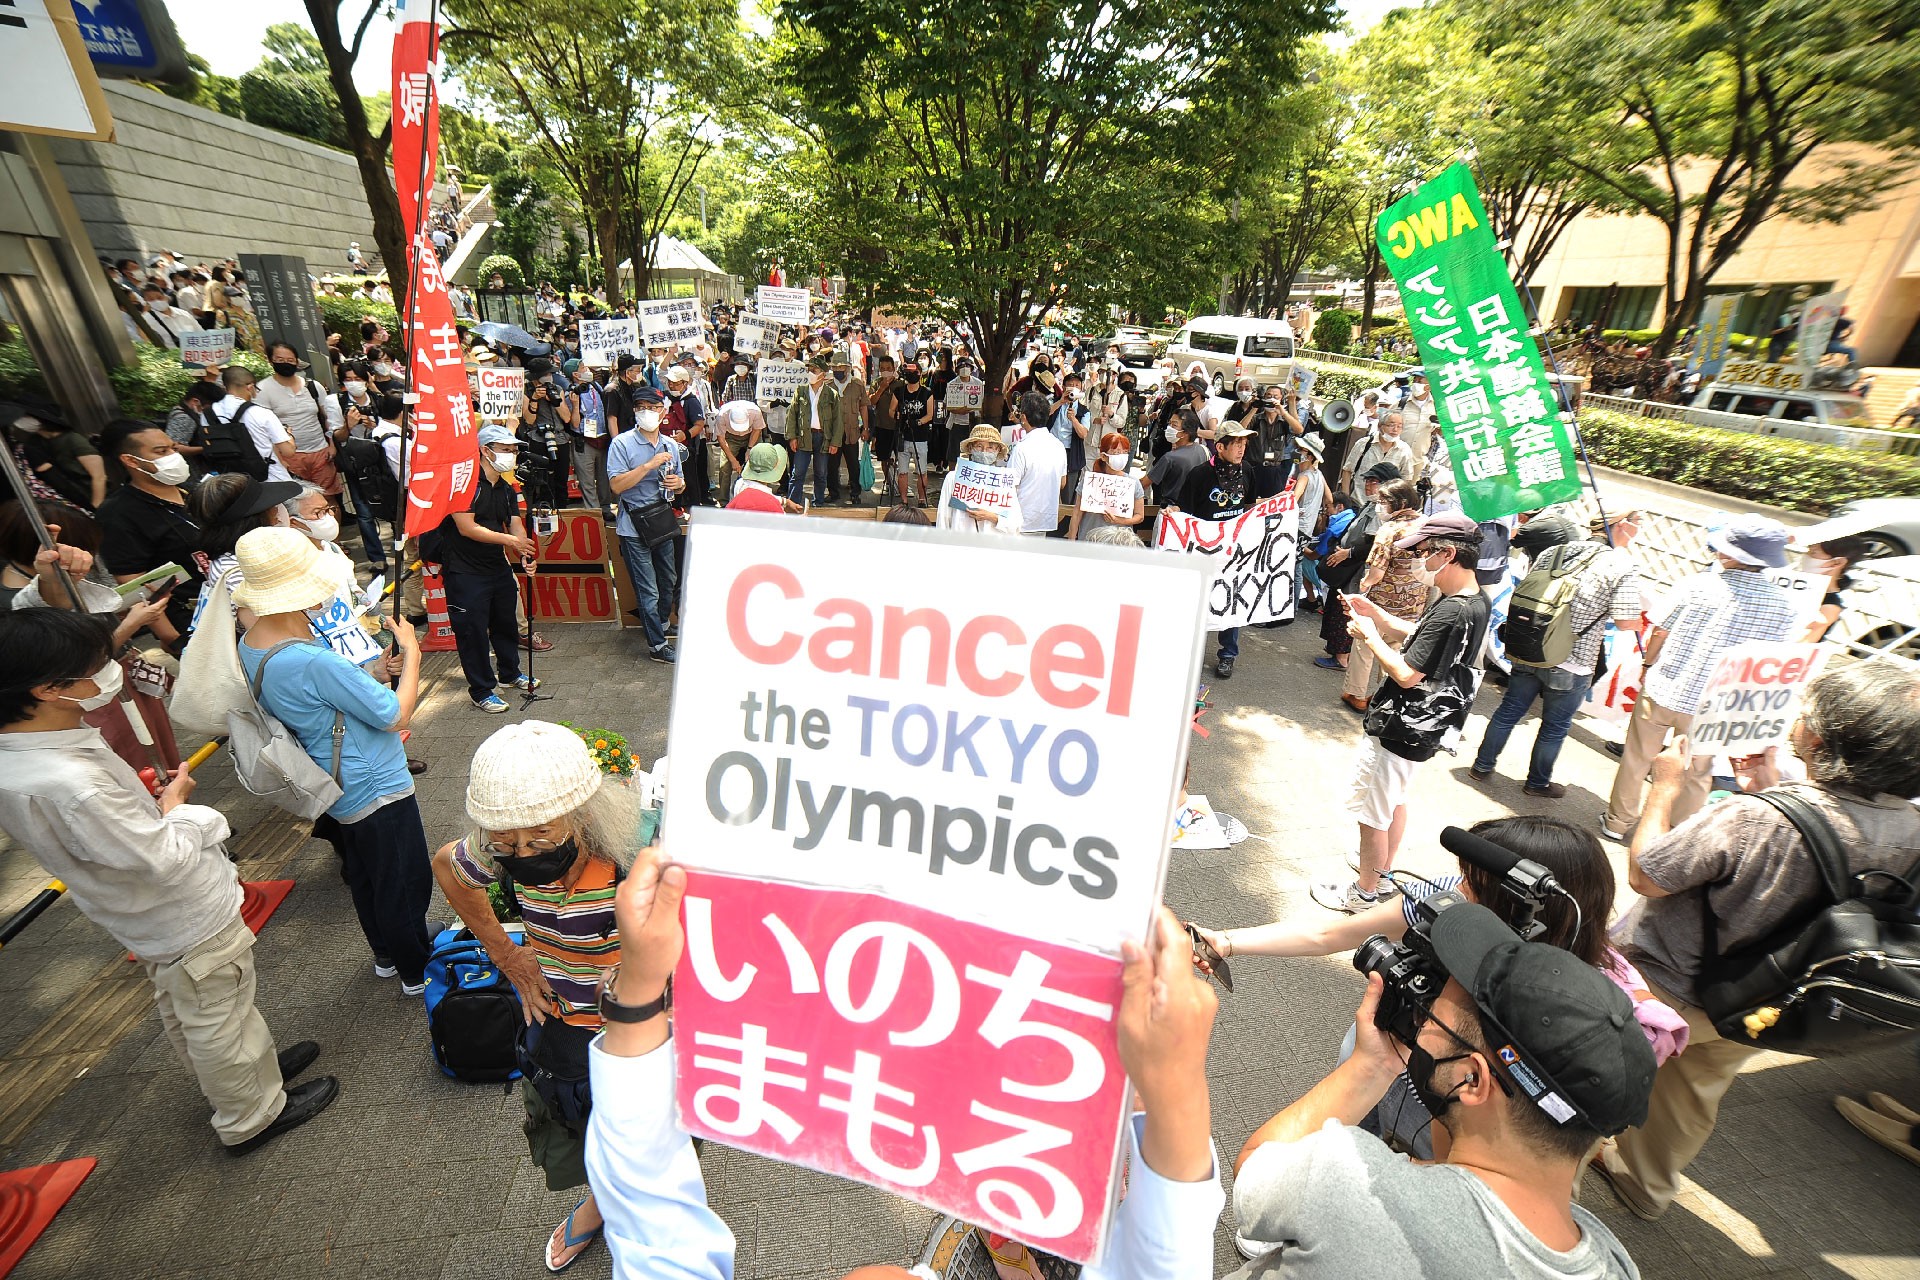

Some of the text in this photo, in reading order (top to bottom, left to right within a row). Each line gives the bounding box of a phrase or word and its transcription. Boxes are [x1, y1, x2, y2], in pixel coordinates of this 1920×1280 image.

[583, 325, 627, 341] オリンピック
[760, 377, 808, 385] パラリンピック
[486, 391, 501, 401] the
[959, 466, 1014, 488] 東京五輪
[952, 482, 1013, 507] 即刻中止
[725, 563, 1145, 718] Cancel
[1714, 689, 1792, 712] TOKYO
[739, 689, 1100, 797] the TOKYO
[705, 750, 1120, 900] Olympics
[685, 895, 1113, 1103] いのち
[693, 1022, 1085, 1239] まもる
